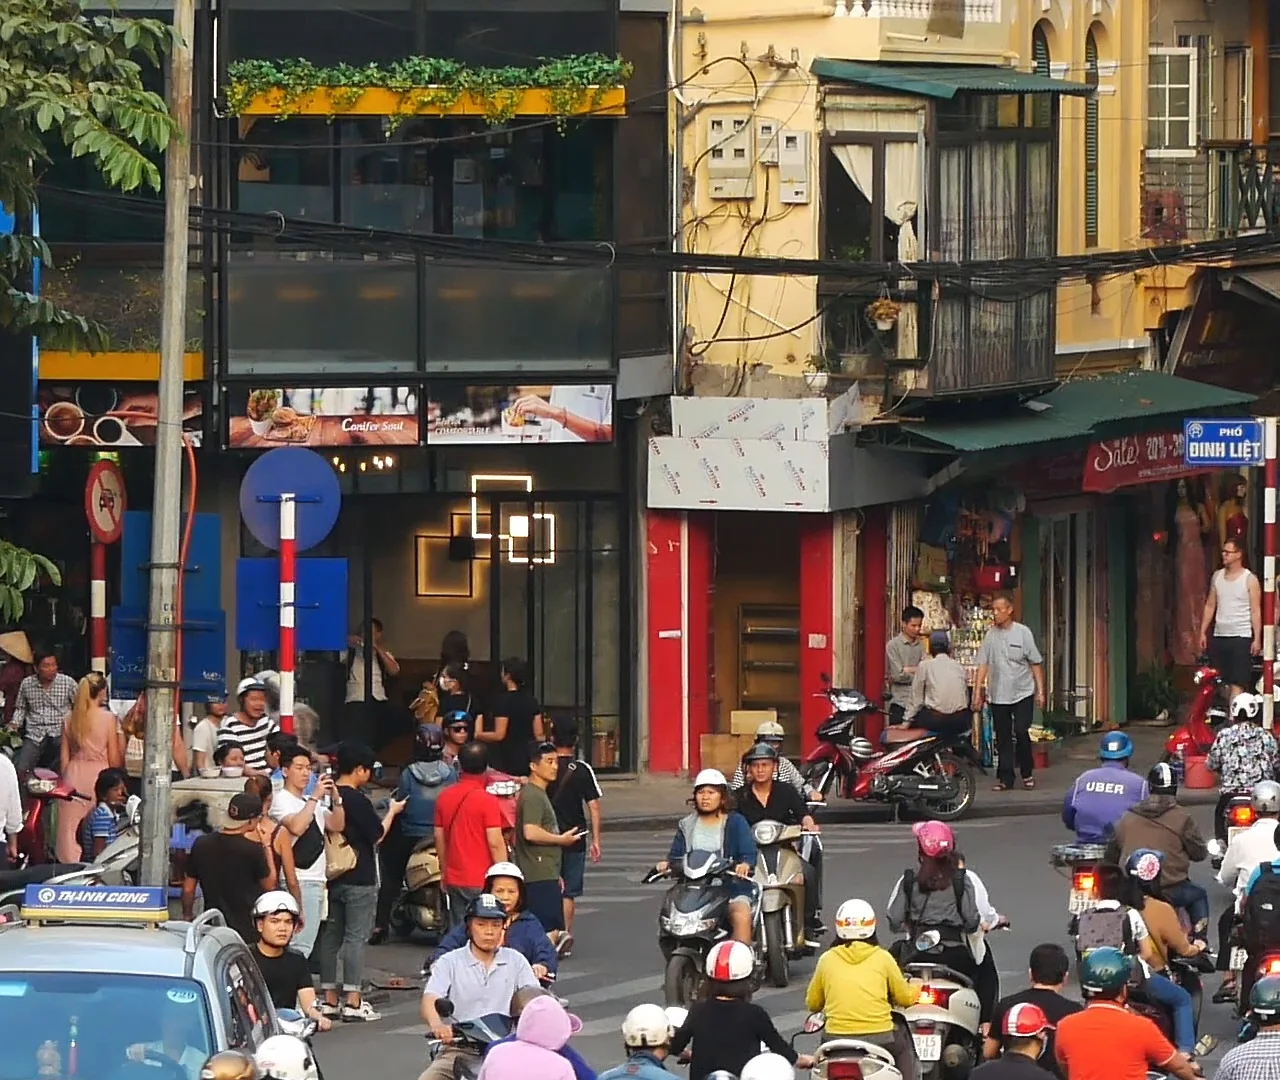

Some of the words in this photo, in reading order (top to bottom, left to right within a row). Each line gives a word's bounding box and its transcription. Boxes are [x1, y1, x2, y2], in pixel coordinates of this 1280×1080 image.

[1219, 424, 1242, 437] PHỐ
[1230, 440, 1261, 462] LIỆT
[1086, 782, 1124, 794] UBER
